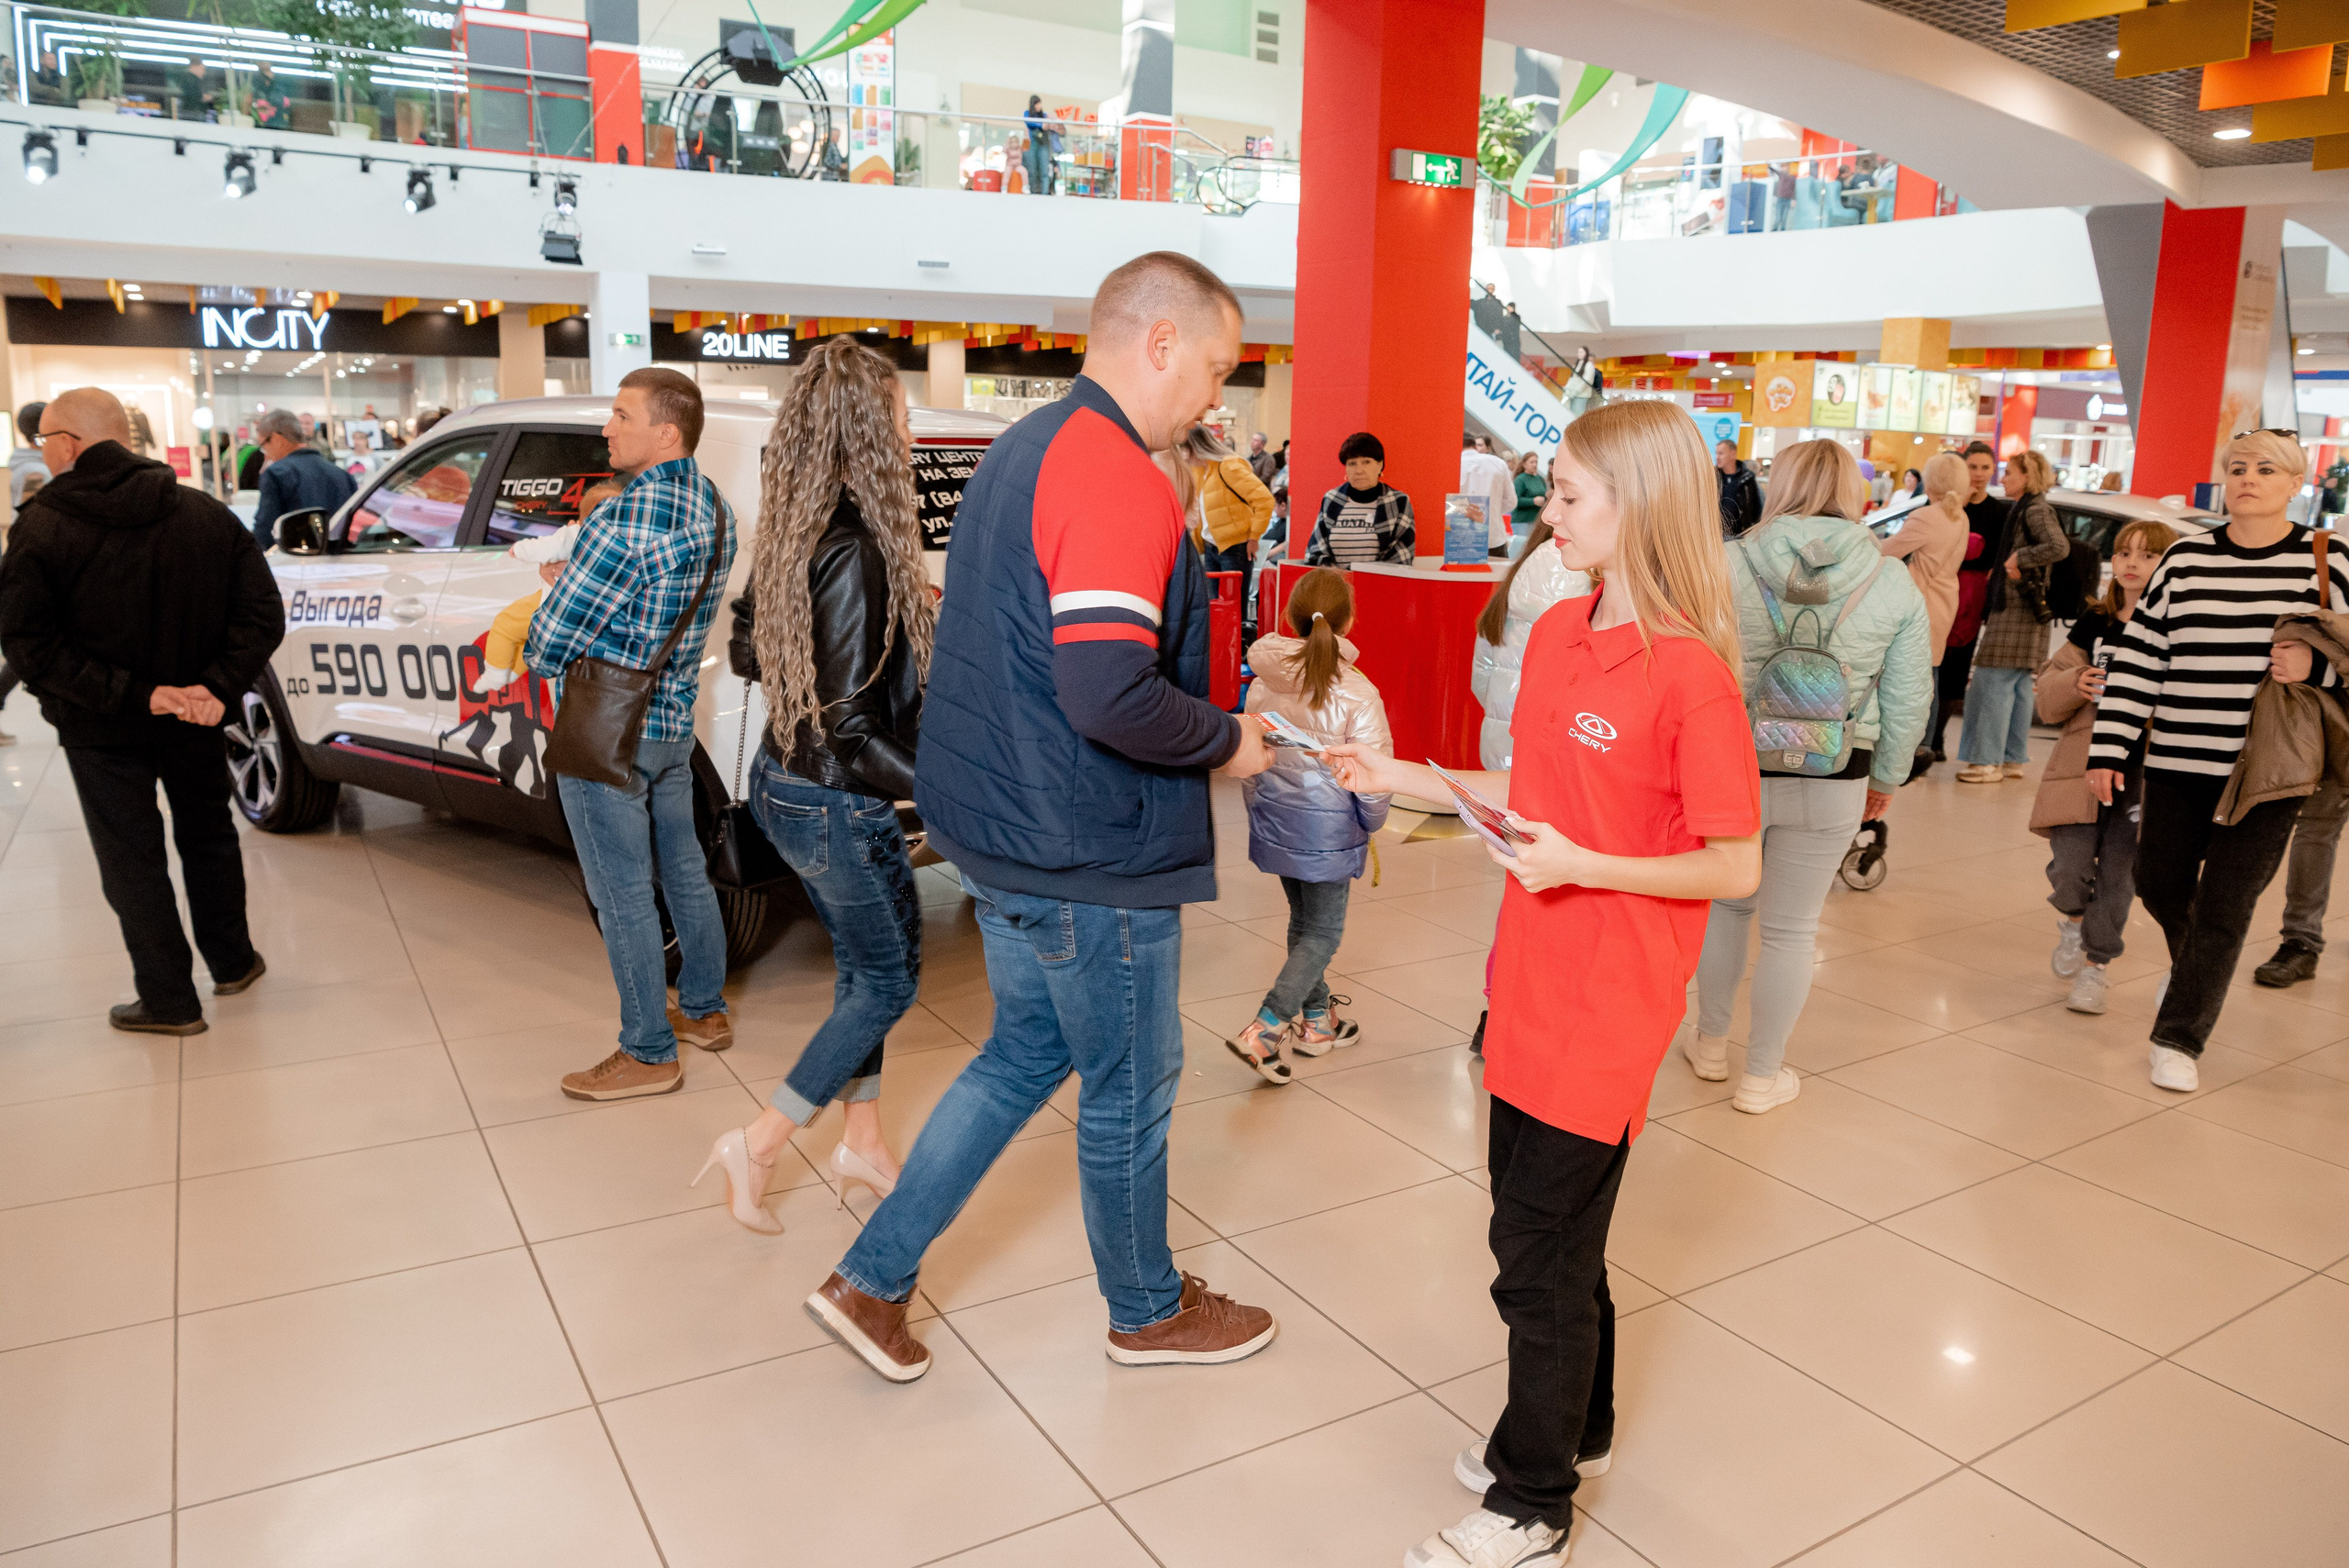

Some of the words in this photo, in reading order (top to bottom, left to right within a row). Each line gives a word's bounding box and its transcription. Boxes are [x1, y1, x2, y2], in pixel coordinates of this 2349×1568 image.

[202, 307, 330, 350] INCITY
[702, 332, 790, 359] 20LINE
[919, 468, 949, 482] НА
[502, 478, 563, 495] TIGGO
[561, 477, 586, 508] 4
[290, 590, 382, 628] Выгода
[287, 677, 309, 697] до
[310, 643, 387, 697] 590
[1568, 728, 1612, 753] CHERY
